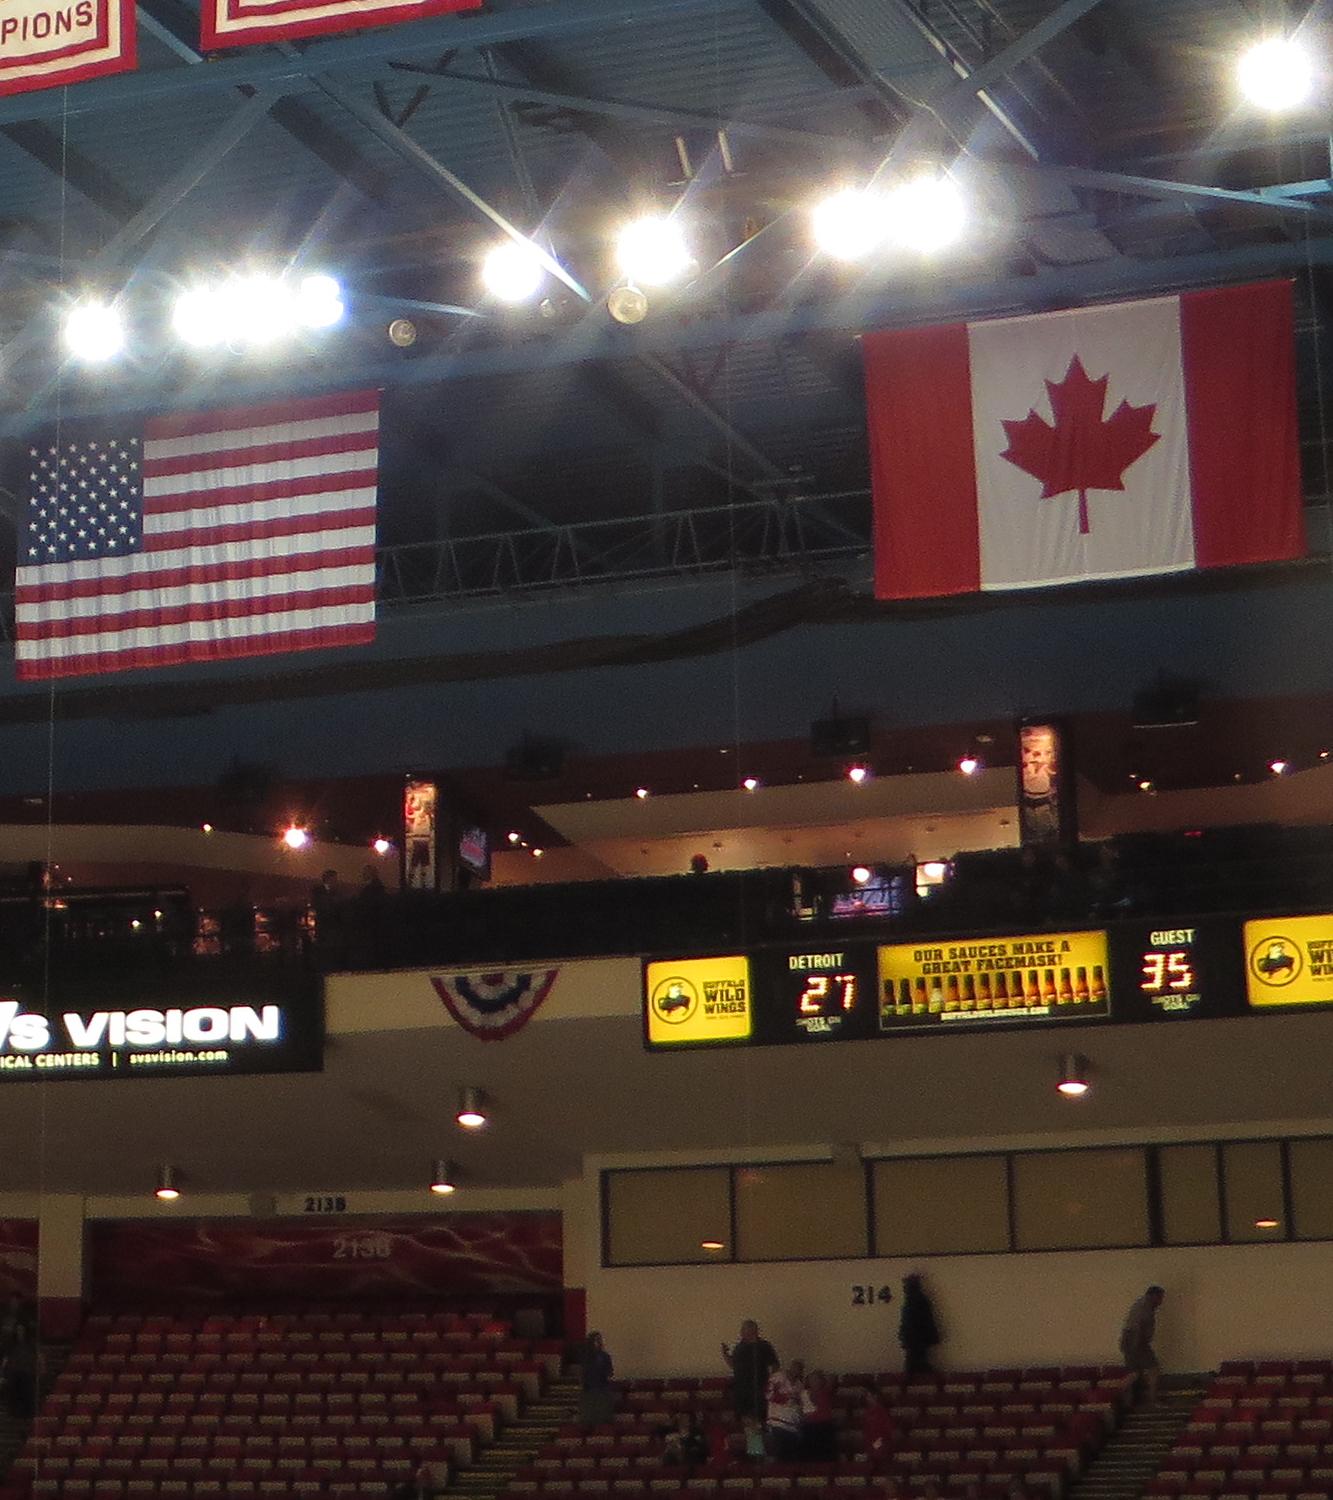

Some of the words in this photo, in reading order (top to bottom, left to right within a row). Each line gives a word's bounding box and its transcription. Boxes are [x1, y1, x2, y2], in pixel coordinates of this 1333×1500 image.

[1150, 929, 1195, 946] GUEST
[914, 950, 943, 962] OUR
[949, 944, 1006, 960] SAUCES
[1013, 941, 1055, 955] MAKE
[1061, 940, 1070, 952] A
[789, 953, 844, 970] DETROIT
[922, 959, 971, 974] GREAT
[977, 954, 1063, 971] FACEMASK!
[1140, 952, 1193, 990] 35
[703, 979, 745, 988] BUFFALO
[704, 988, 746, 1002] WILD
[798, 974, 859, 1013] 27
[705, 1002, 746, 1014] WINGS
[62, 1006, 280, 1047] VISION
[35, 1052, 100, 1068] CENTERS
[129, 1049, 227, 1065] svsvision.com
[304, 1196, 347, 1212] 213B
[851, 1285, 893, 1305] 214
